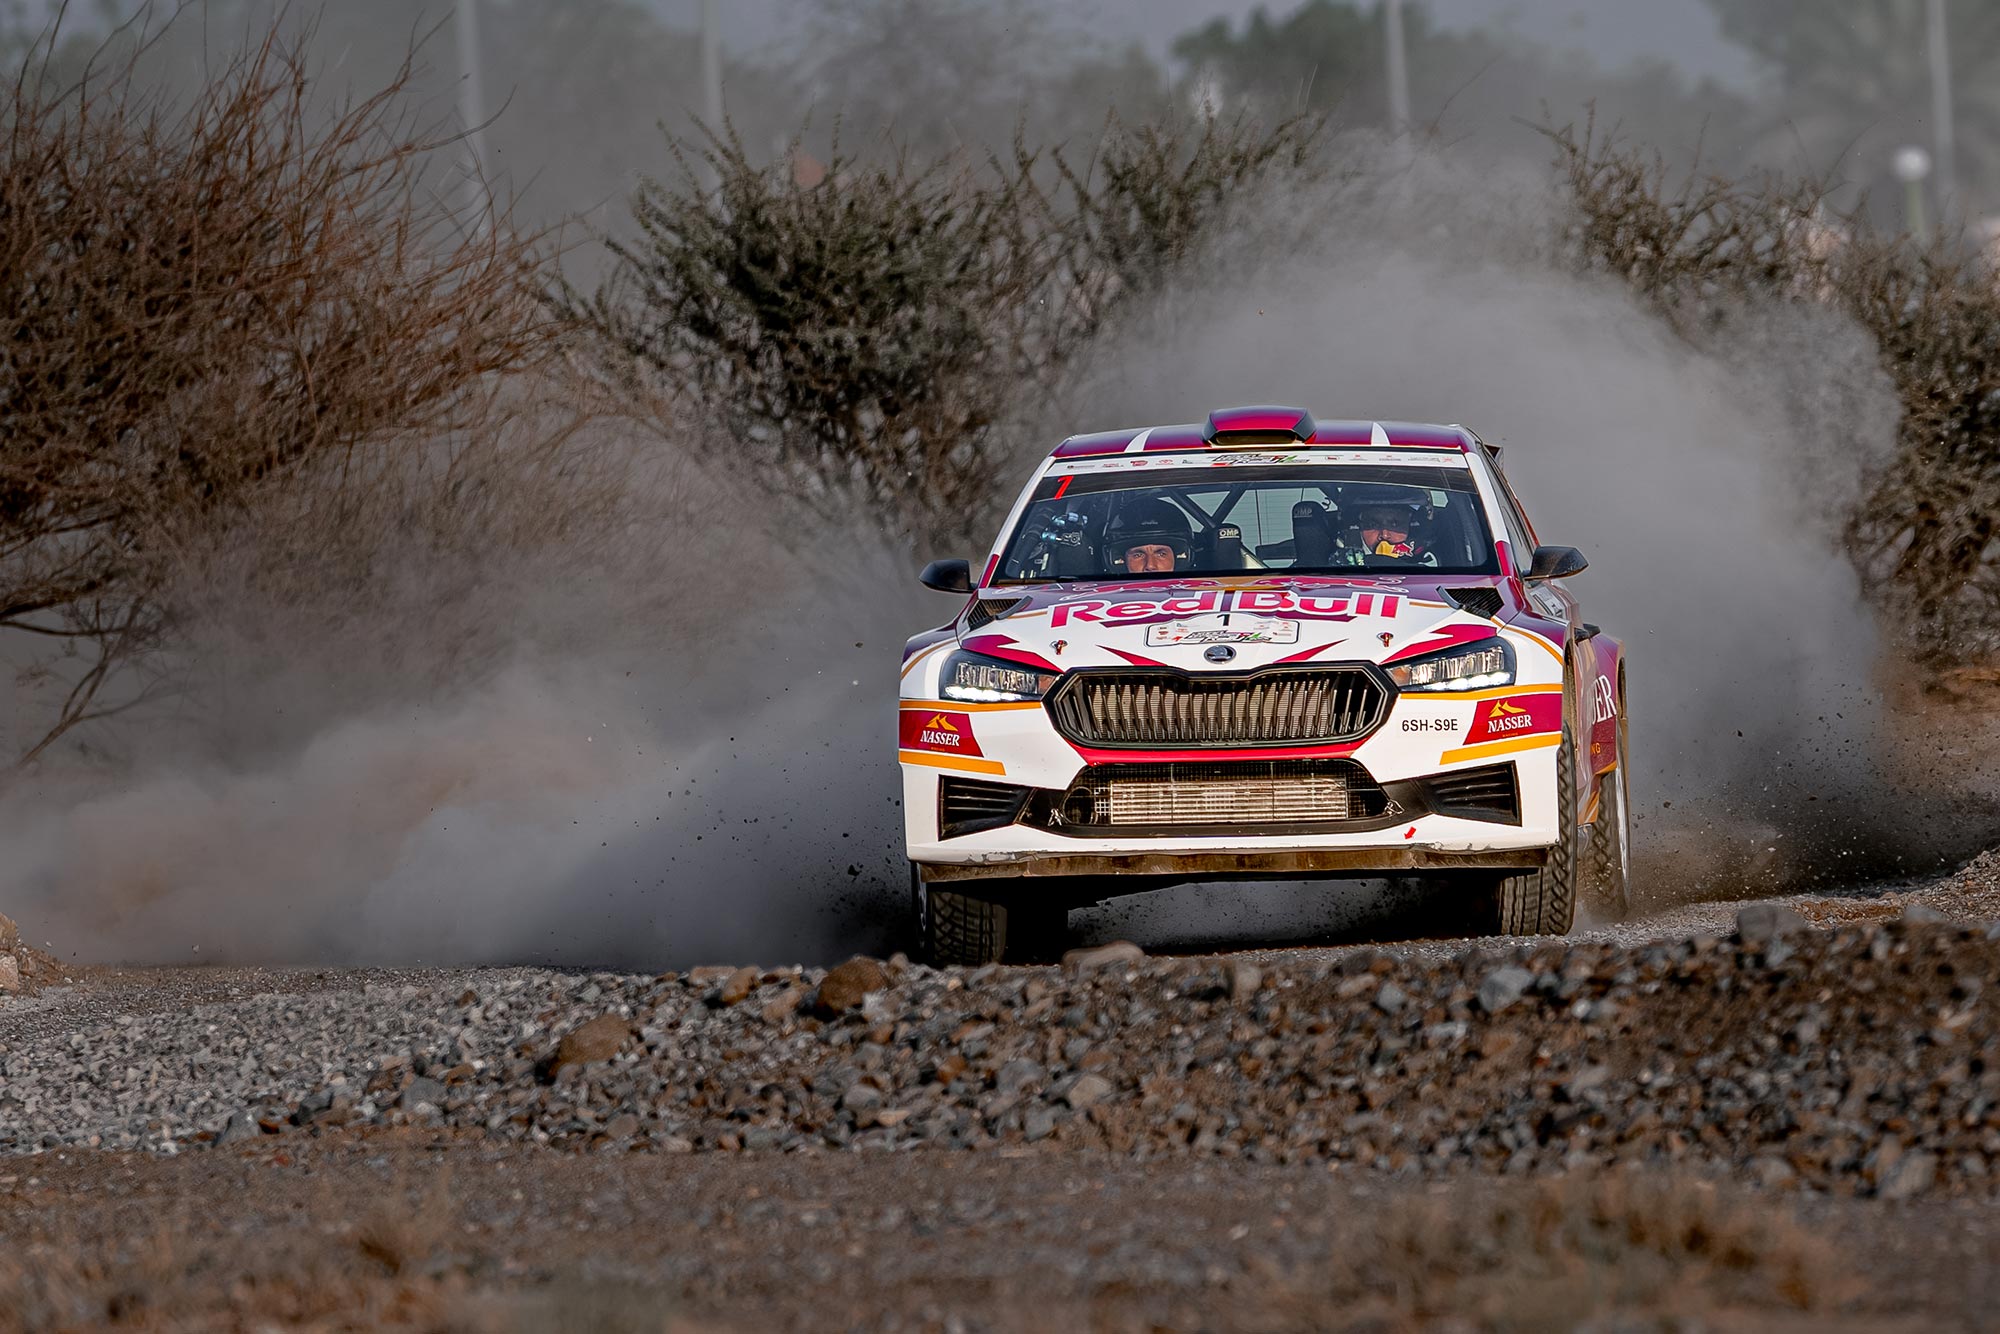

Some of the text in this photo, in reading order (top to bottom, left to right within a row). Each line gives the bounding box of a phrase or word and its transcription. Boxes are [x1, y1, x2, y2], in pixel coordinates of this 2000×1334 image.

[1219, 529, 1240, 537] OMP
[1049, 590, 1400, 628] Red Bull
[1217, 613, 1231, 627] 1
[1401, 718, 1459, 732] 6SH-S9E
[1487, 714, 1533, 734] NASSER
[920, 730, 960, 747] NASSER
